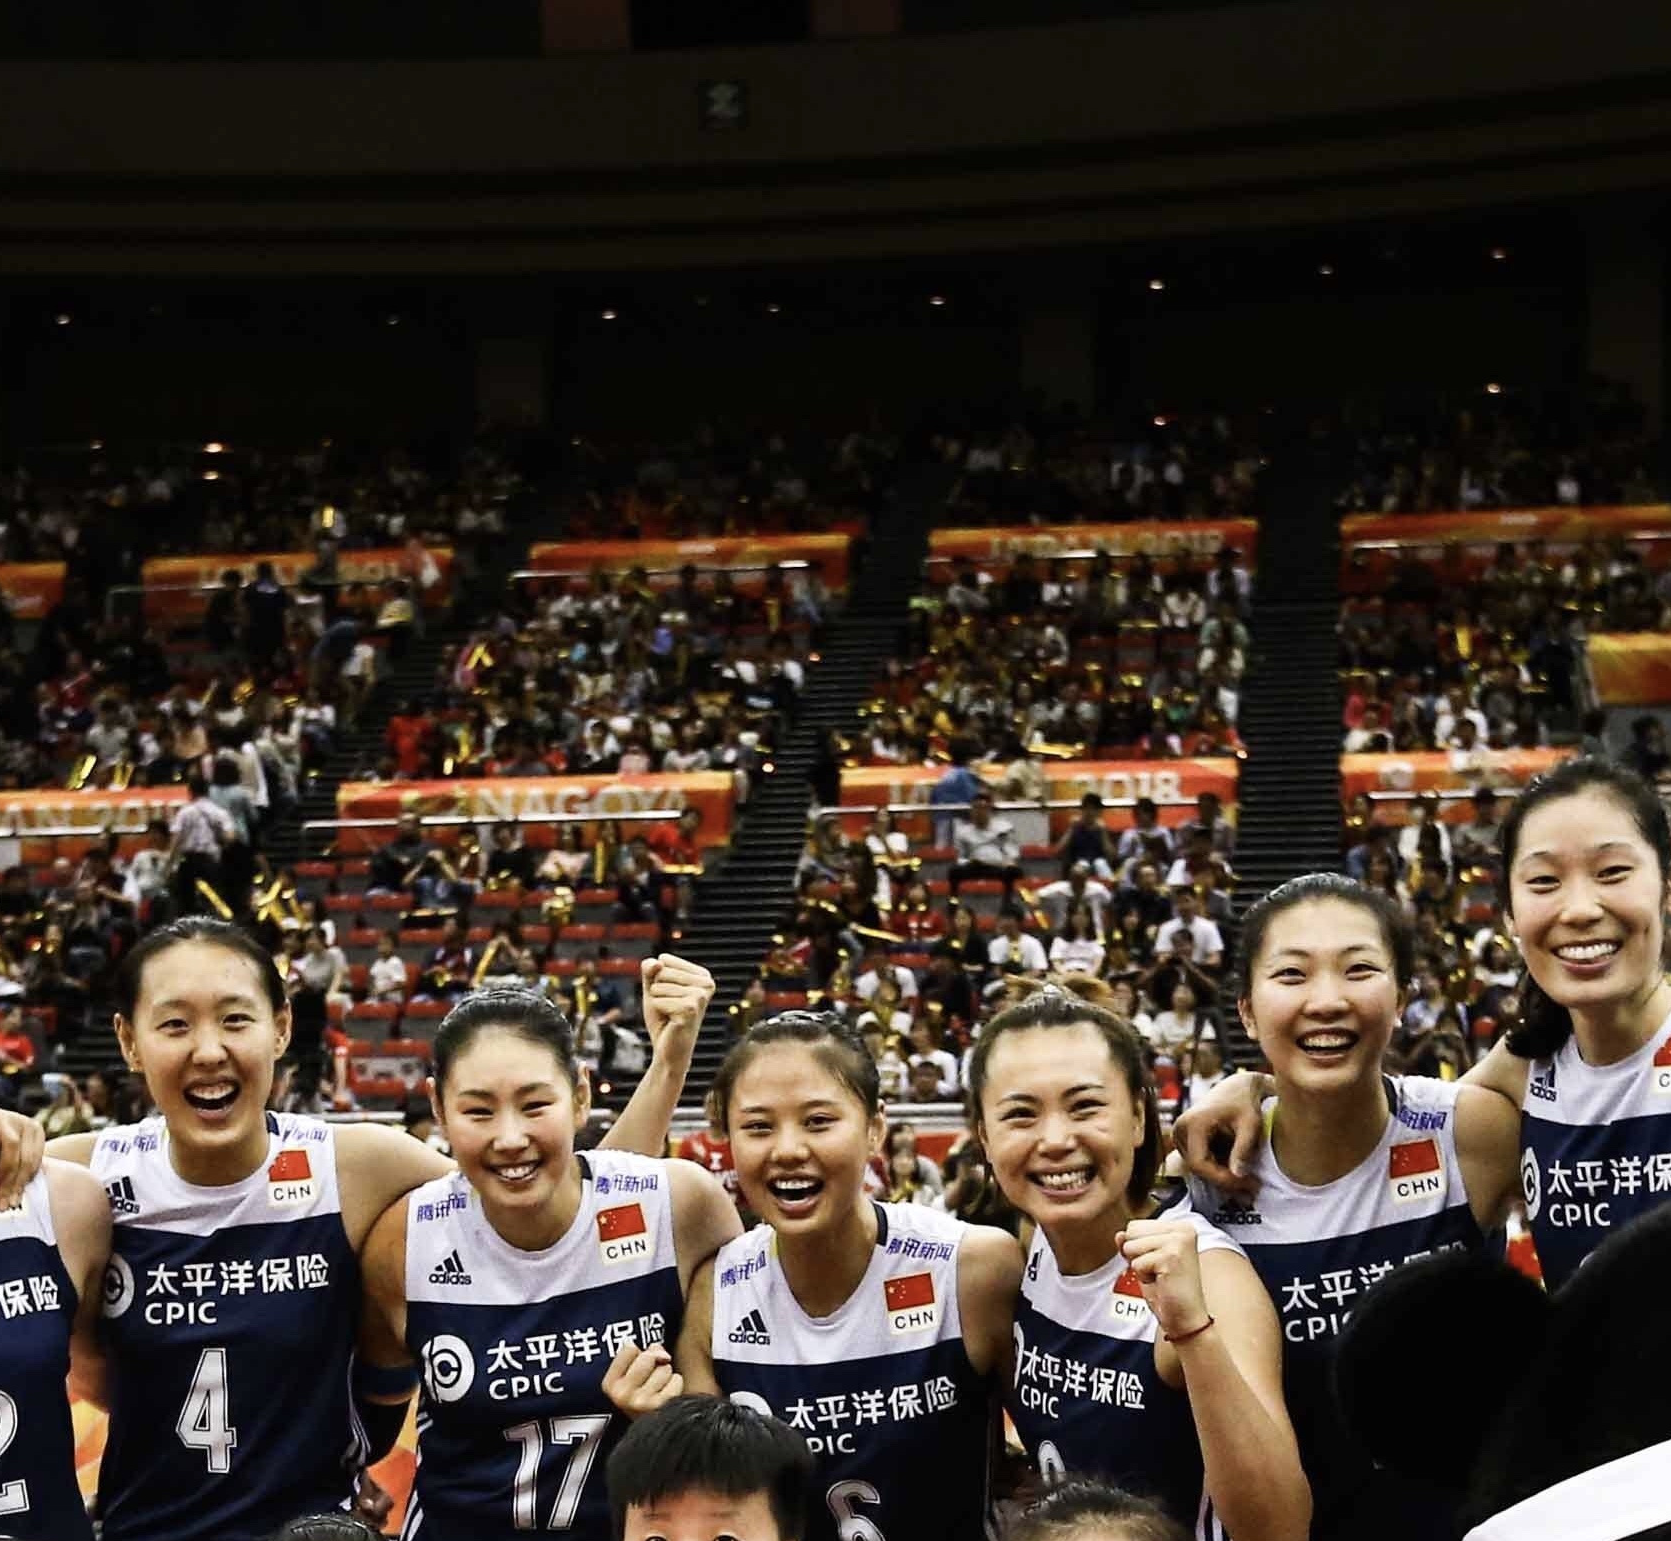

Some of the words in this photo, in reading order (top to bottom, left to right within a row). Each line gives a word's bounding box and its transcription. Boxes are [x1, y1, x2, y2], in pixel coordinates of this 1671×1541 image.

[273, 1185, 313, 1202] CHN
[1397, 1175, 1440, 1198] CHN
[1212, 1211, 1262, 1226] adidas
[1549, 1202, 1611, 1227] CPIC
[606, 1239, 648, 1260] CHN
[145, 1253, 330, 1297] 太平洋保险
[428, 1269, 472, 1286] adidas
[144, 1301, 218, 1325] CPIC
[894, 1311, 934, 1331] CHN
[488, 1372, 565, 1400] CPIC
[1022, 1345, 1145, 1410] 太平洋保险
[176, 1347, 238, 1474] 4
[785, 1375, 959, 1431] 太平洋保险
[1020, 1383, 1060, 1419] CPIC
[805, 1432, 857, 1456] PIC
[503, 1413, 613, 1531] 17
